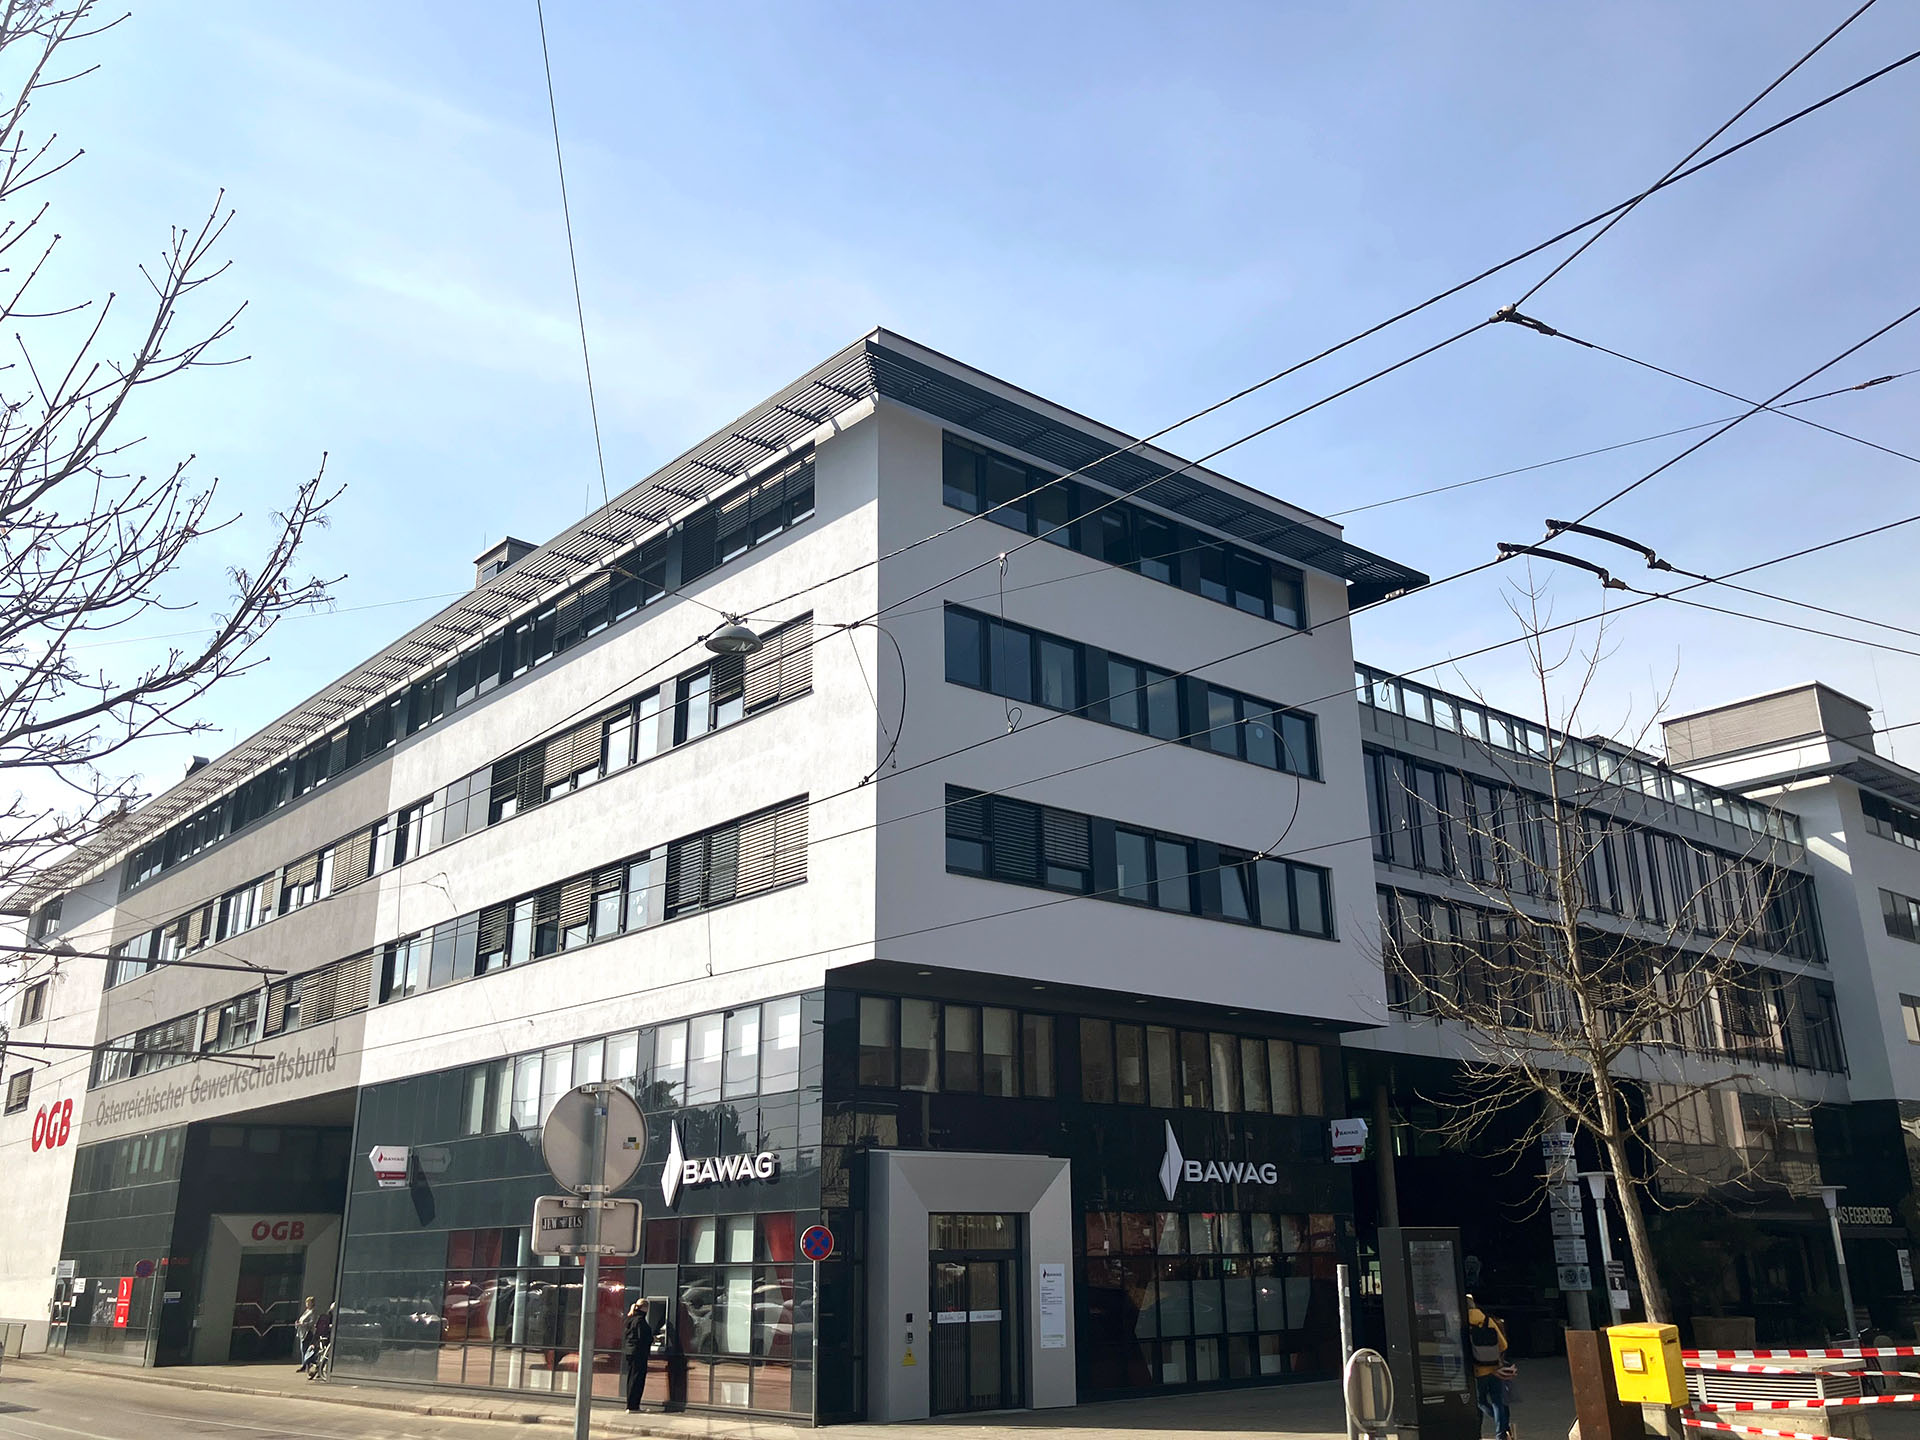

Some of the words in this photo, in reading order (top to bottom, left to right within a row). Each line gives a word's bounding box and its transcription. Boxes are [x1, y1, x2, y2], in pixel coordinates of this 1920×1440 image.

[96, 1080, 187, 1127] Österreichischer
[190, 1037, 339, 1105] Gewerkschaftsbund
[682, 1151, 776, 1185] BAWAG
[1183, 1160, 1278, 1185] BAWAG
[1848, 1206, 1893, 1225] EGGENBERG
